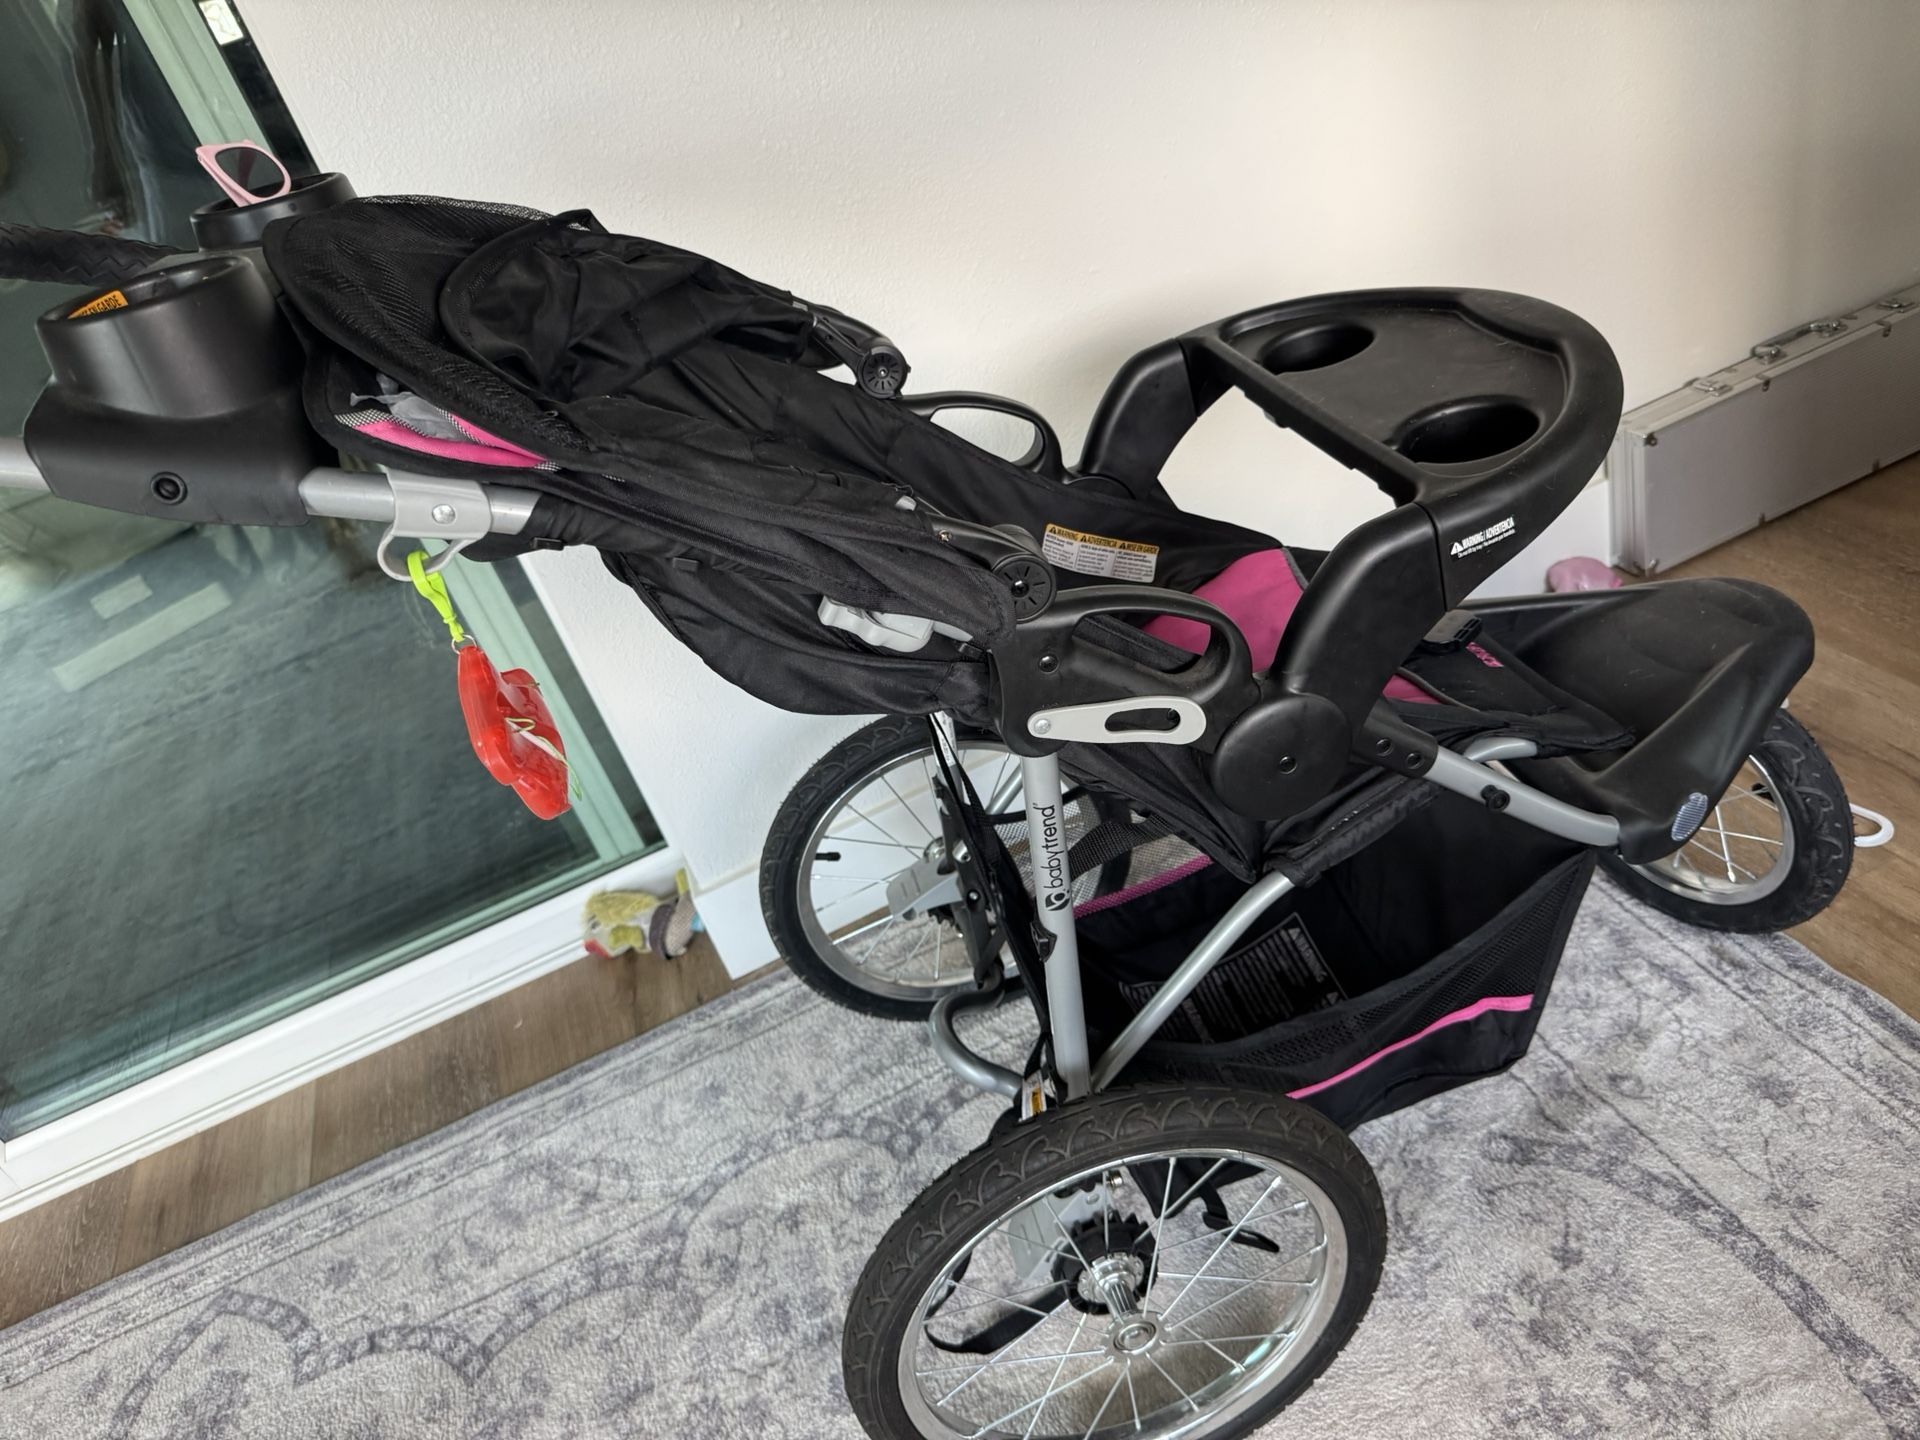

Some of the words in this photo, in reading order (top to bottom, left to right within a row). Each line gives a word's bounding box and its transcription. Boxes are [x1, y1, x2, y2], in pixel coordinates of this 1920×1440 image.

[1057, 528, 1078, 541] WARNING
[1087, 536, 1117, 548] ADVERTENCIA
[1461, 531, 1485, 549] WARNING
[1485, 517, 1516, 539] ADVERTENCIA
[1033, 803, 1064, 889] babytrend
